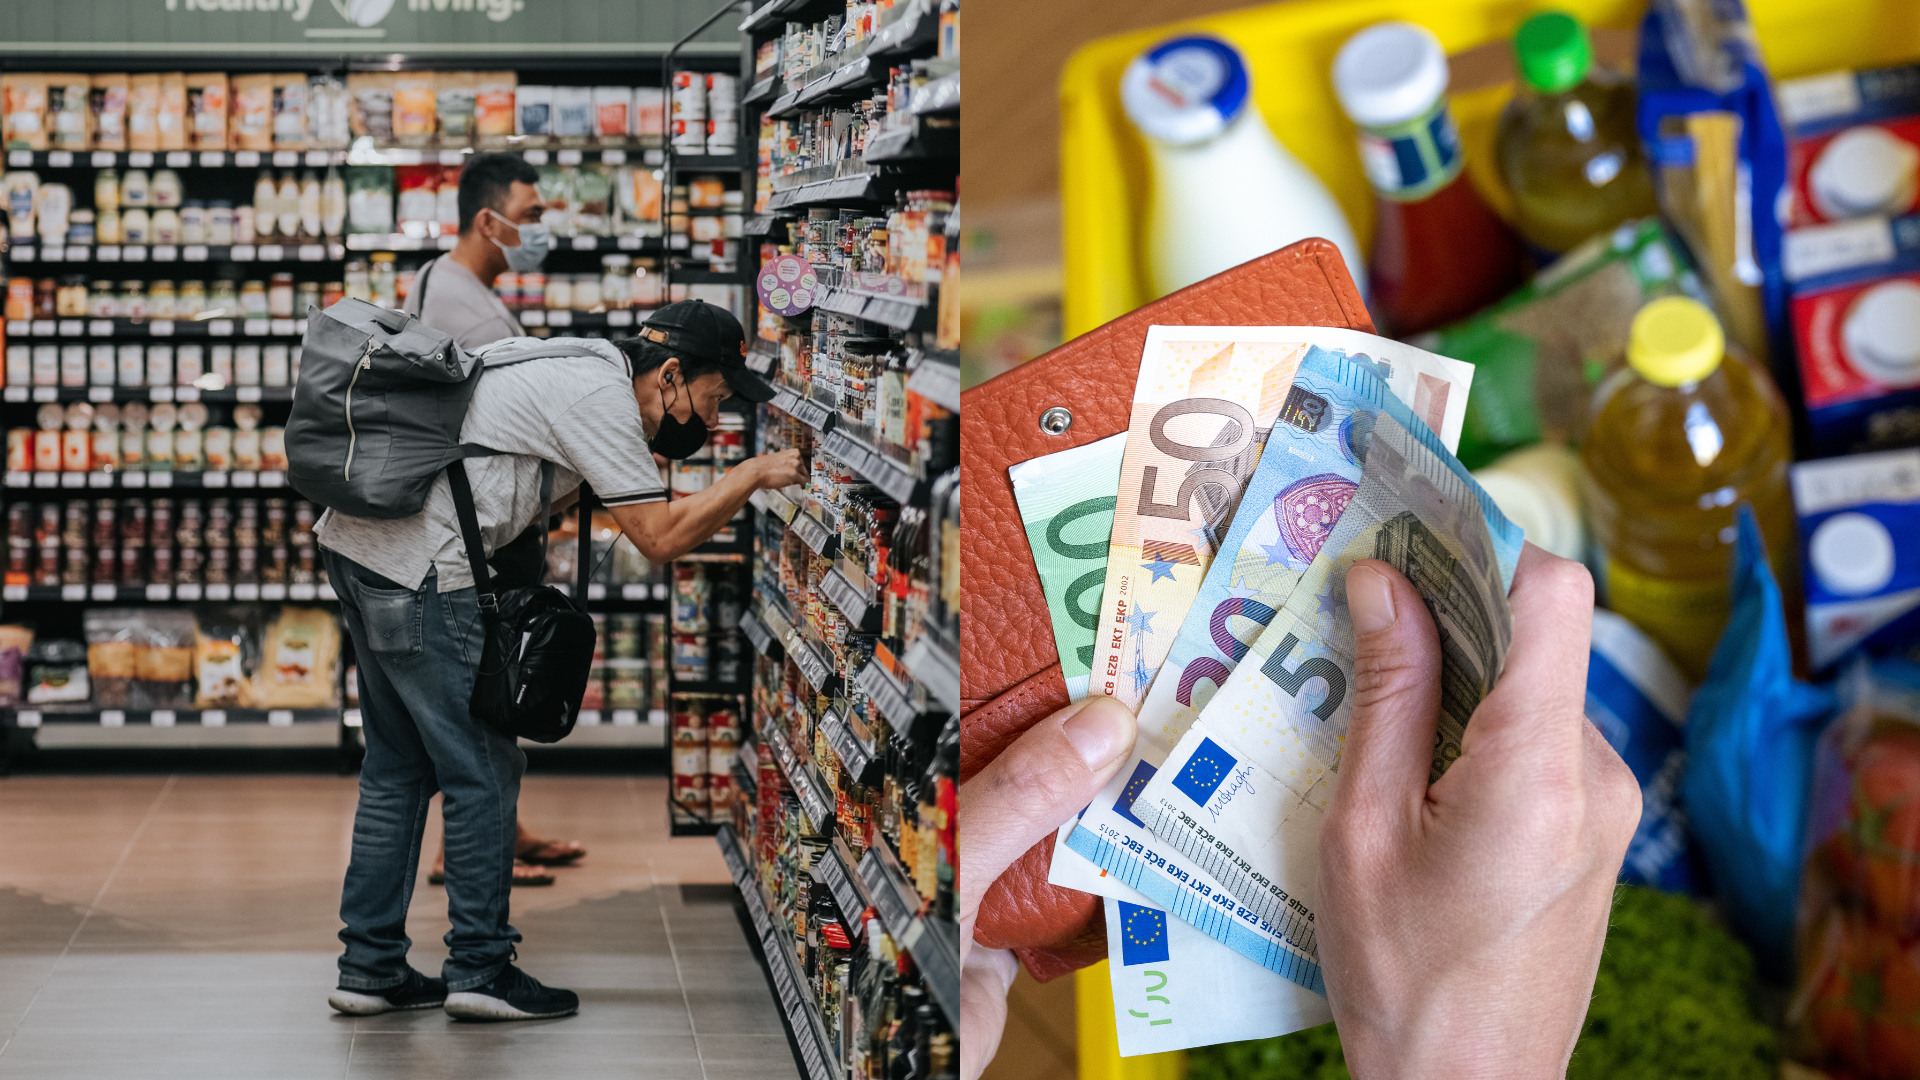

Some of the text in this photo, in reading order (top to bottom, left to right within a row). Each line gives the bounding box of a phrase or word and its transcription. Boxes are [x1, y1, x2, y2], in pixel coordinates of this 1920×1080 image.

[1137, 397, 1255, 528] 50
[1120, 575, 1129, 596] 2002
[1115, 599, 1127, 624] EKP
[1111, 628, 1123, 649] EKT
[1107, 655, 1118, 677] EZB
[1260, 632, 1347, 722] 5
[1159, 797, 1177, 814] 2013
[1177, 810, 1197, 830] EBC
[1098, 823, 1120, 840] 2015
[1120, 835, 1145, 855] EBC
[1214, 840, 1235, 859] EKB
[1166, 863, 1190, 883] EKB
[1232, 855, 1252, 873] EKT
[1188, 878, 1212, 897] EKT
[1250, 872, 1271, 889] EKP
[1212, 893, 1236, 912] EKP
[1269, 884, 1289, 902] EZB
[1236, 906, 1260, 925] EZB
